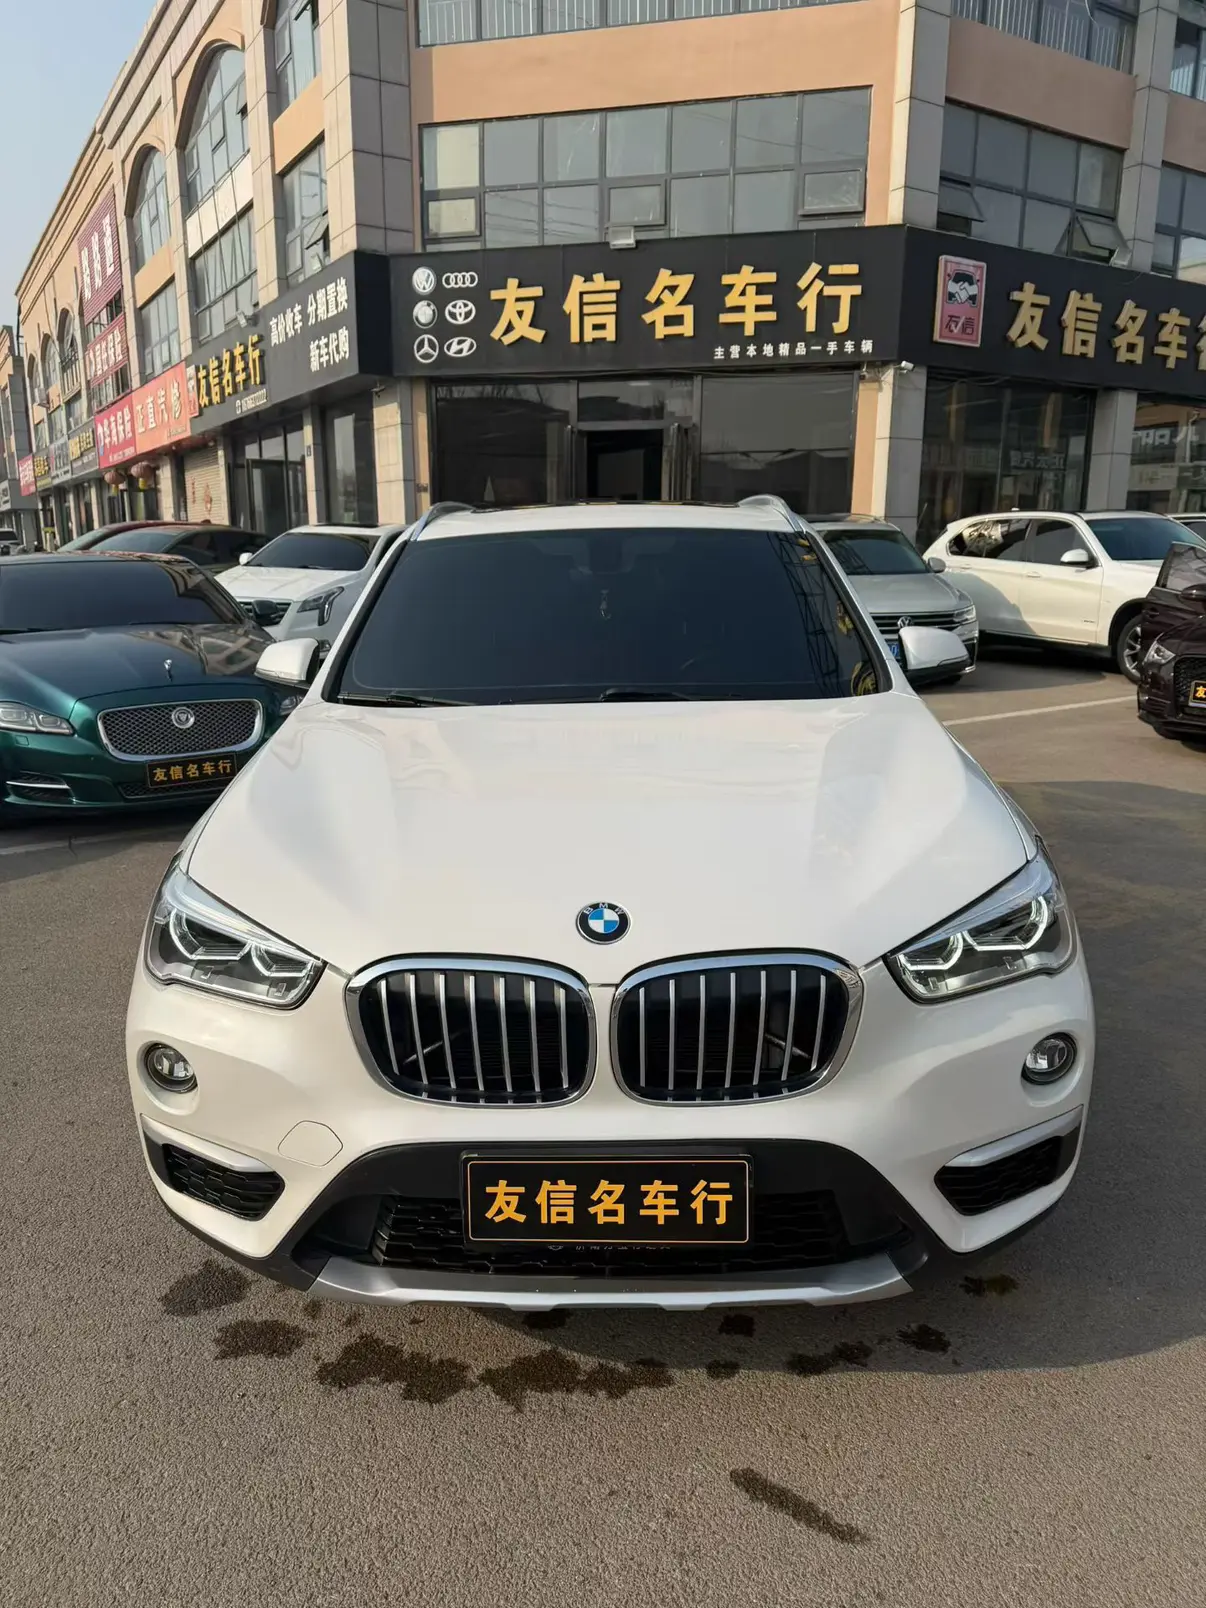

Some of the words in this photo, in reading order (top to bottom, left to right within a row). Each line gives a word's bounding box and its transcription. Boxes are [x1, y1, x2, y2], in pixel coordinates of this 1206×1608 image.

[269, 303, 303, 347] 高价收车
[307, 276, 348, 326] 分期置换
[490, 261, 862, 346] 友信名车行
[1006, 281, 1206, 371] 友信名车
[198, 334, 261, 408] 友信名车行
[309, 325, 350, 372] 新车代购
[713, 339, 874, 359] 主营本地精品一手车辆
[136, 378, 182, 433] 正直汽修
[152, 760, 232, 782] 友信名车行
[484, 1179, 733, 1225] 友信名车行
